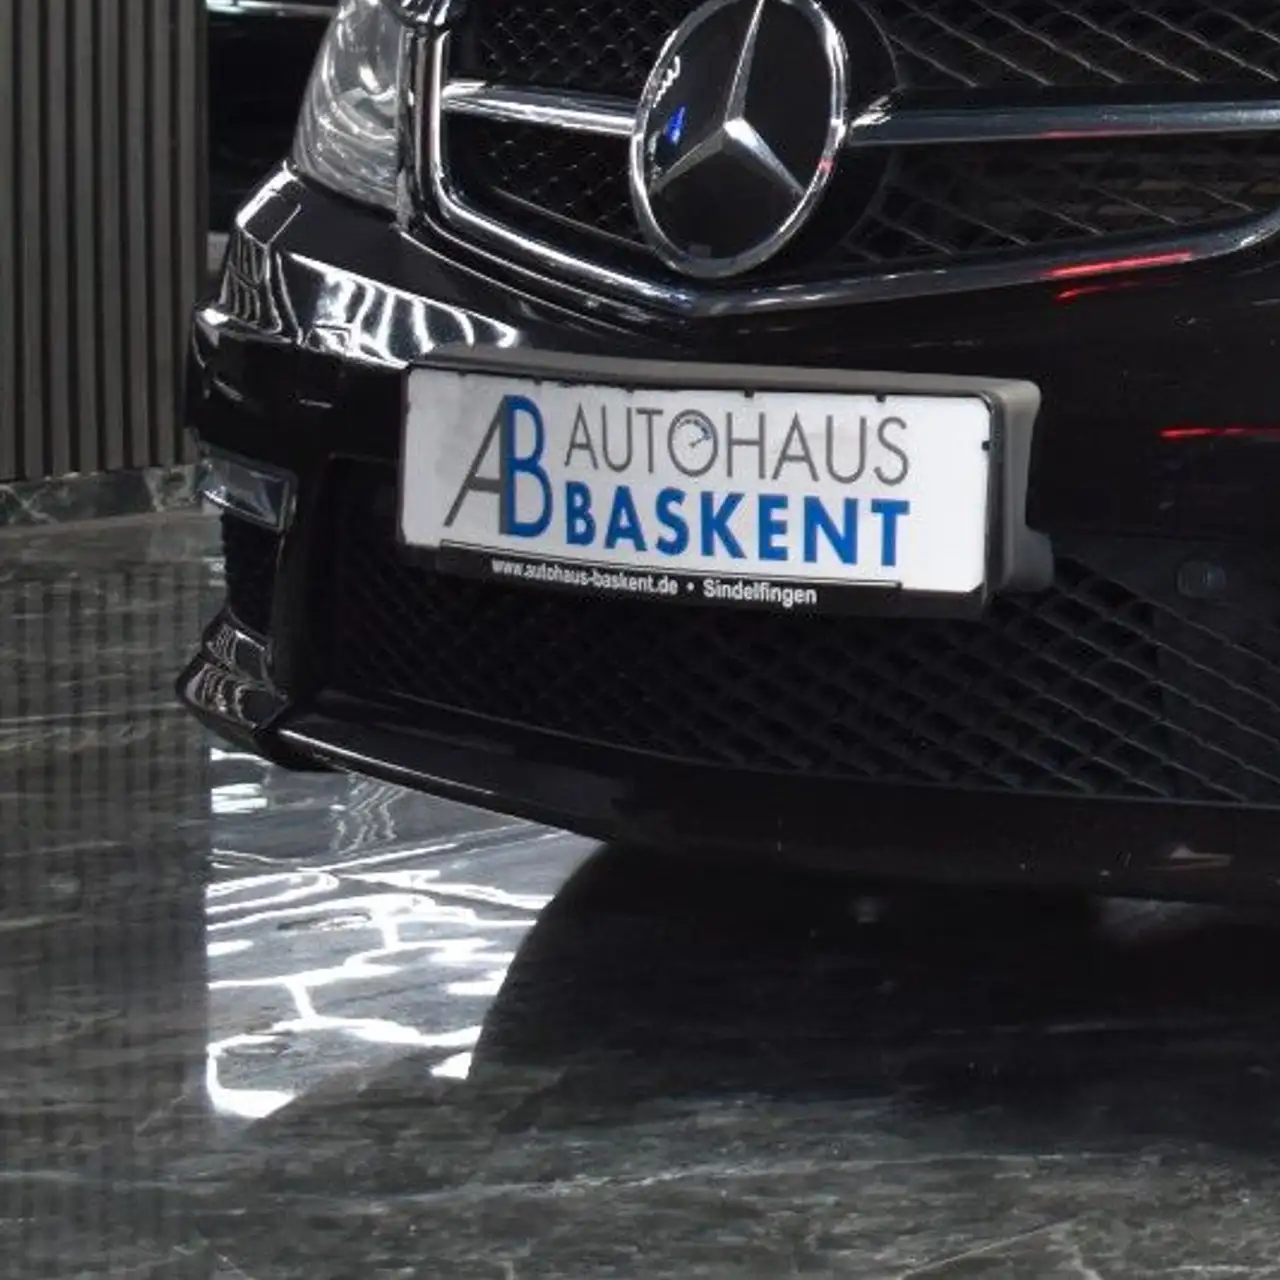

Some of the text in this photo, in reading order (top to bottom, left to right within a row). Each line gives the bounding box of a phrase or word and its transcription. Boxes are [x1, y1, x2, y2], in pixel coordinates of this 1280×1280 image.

[443, 394, 553, 538] AB
[564, 403, 910, 486] AUTOHAUS
[564, 481, 911, 567] BASKENT
[491, 558, 818, 607] www.autohaus-baskent.de Sindelfingen
